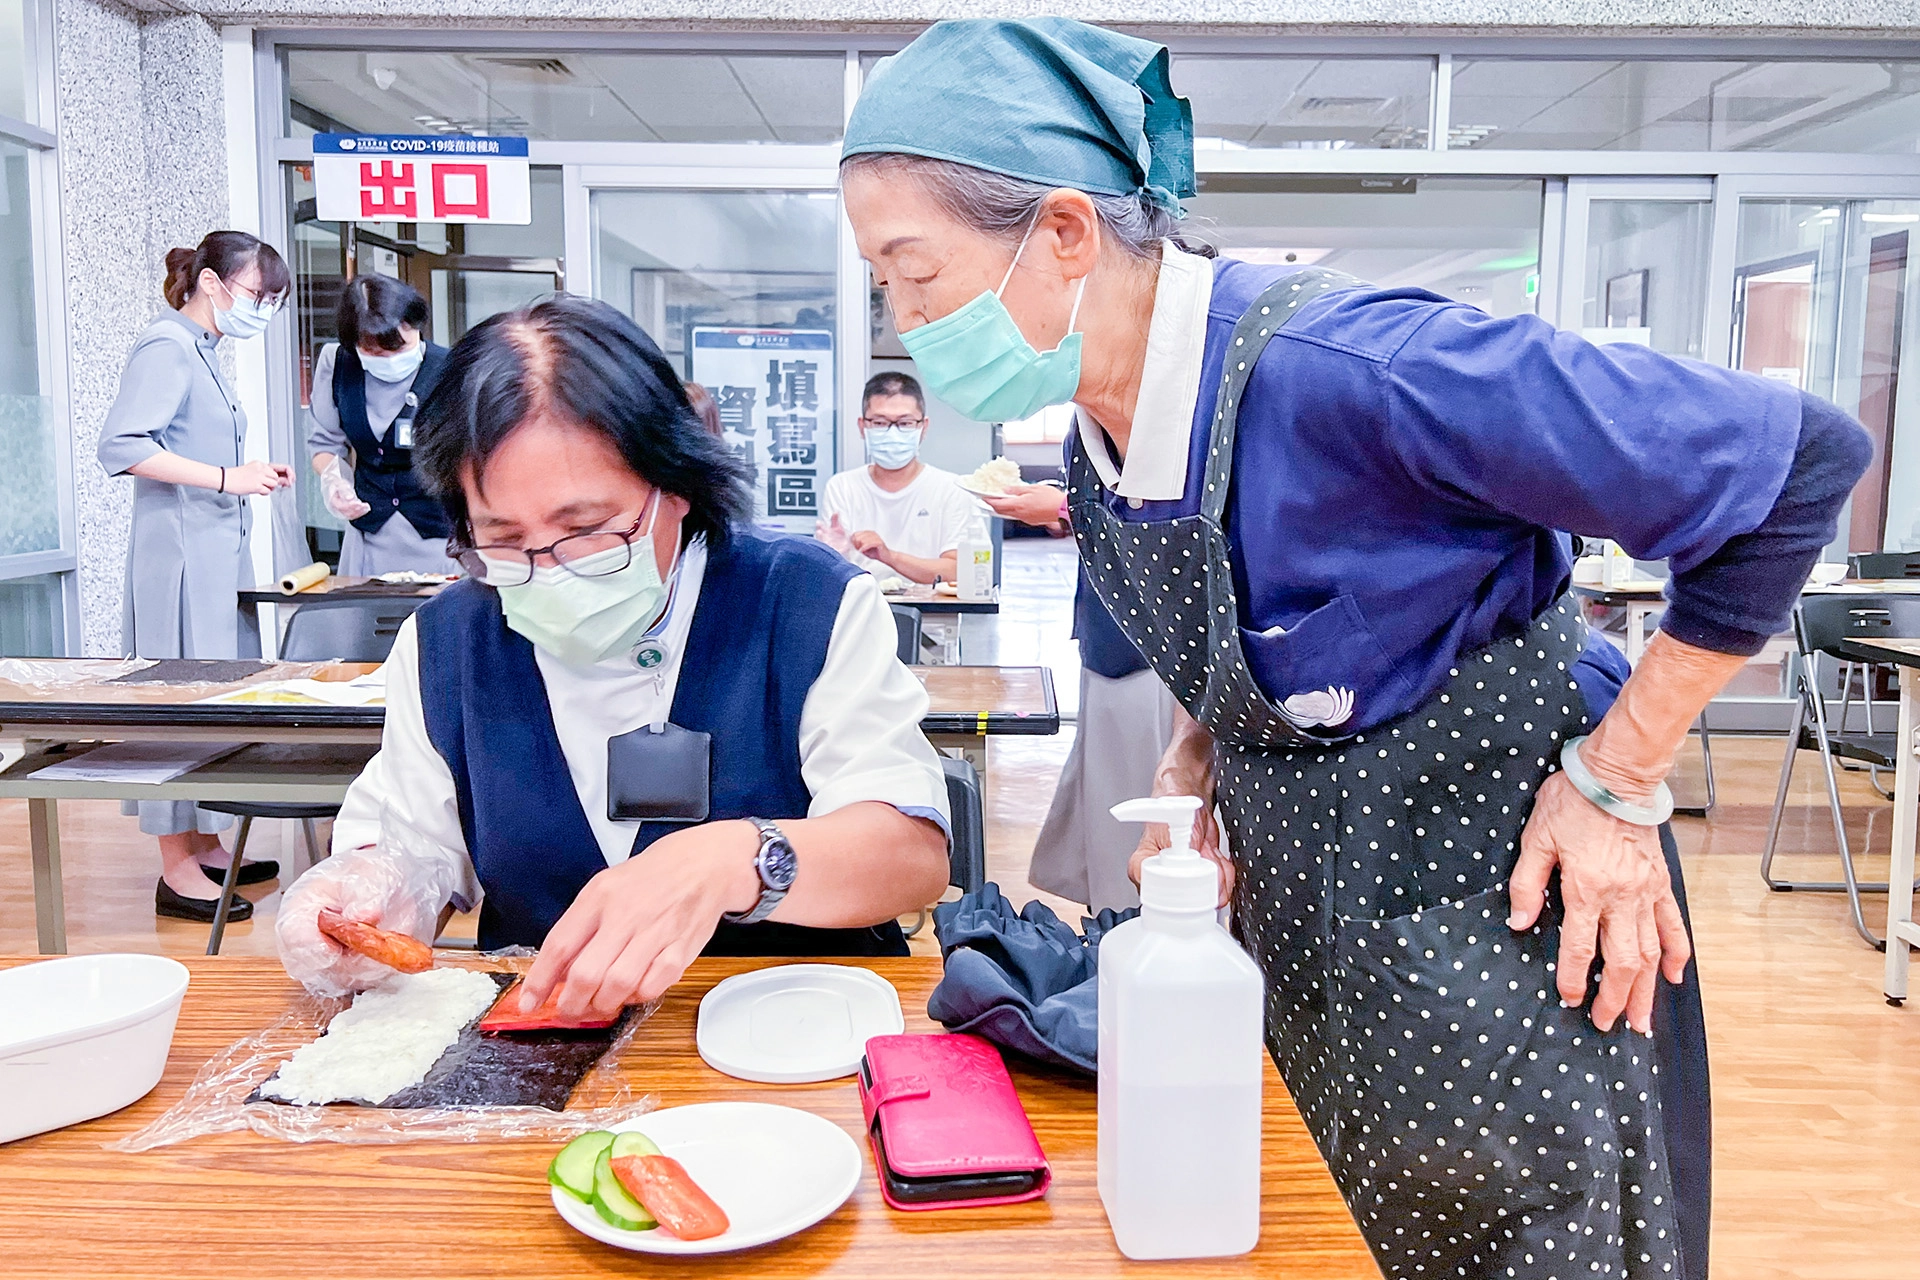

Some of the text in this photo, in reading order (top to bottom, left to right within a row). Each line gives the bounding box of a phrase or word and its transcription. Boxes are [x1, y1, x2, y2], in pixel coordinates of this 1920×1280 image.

[360, 160, 490, 218] 出口
[766, 360, 818, 516] 填寫區
